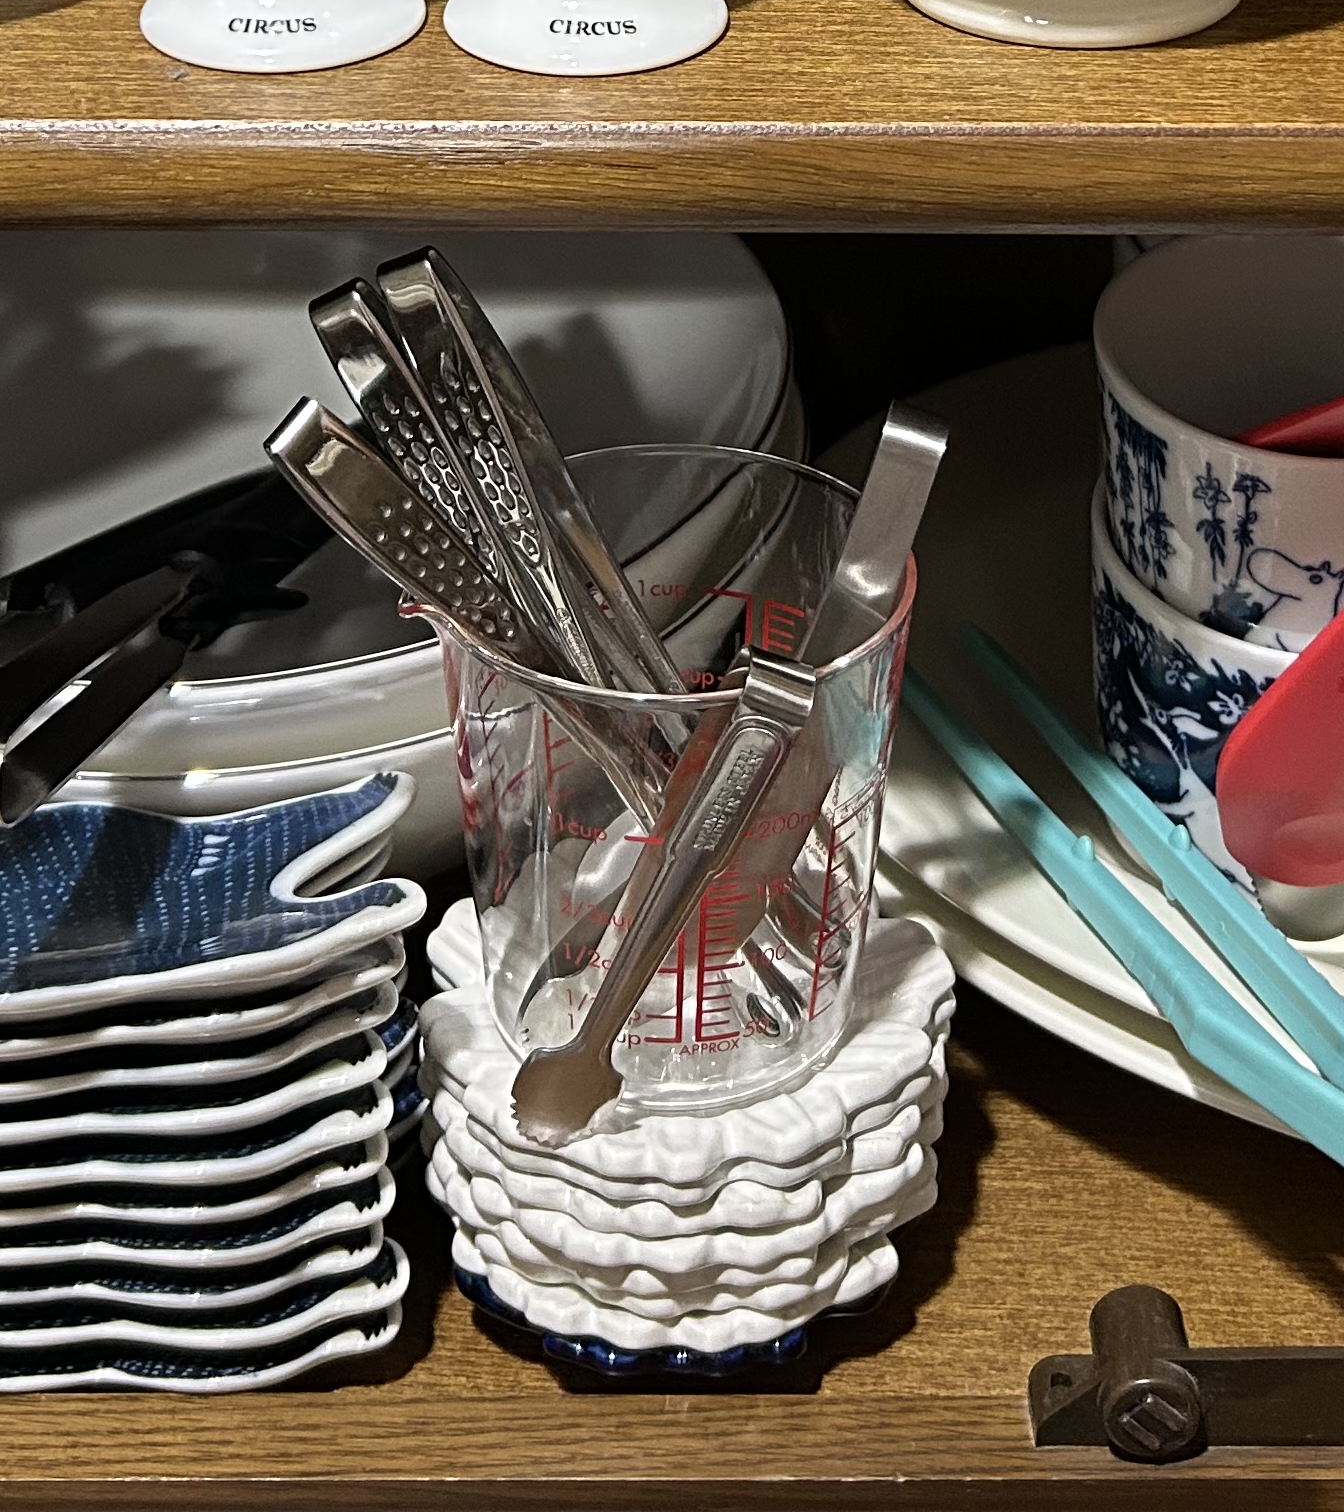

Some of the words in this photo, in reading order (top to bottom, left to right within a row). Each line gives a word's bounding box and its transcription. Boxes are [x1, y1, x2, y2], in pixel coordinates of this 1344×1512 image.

[227, 17, 317, 34] CIRCUS
[548, 18, 637, 36] CIRCUS
[679, 1038, 740, 1055] APPROX
